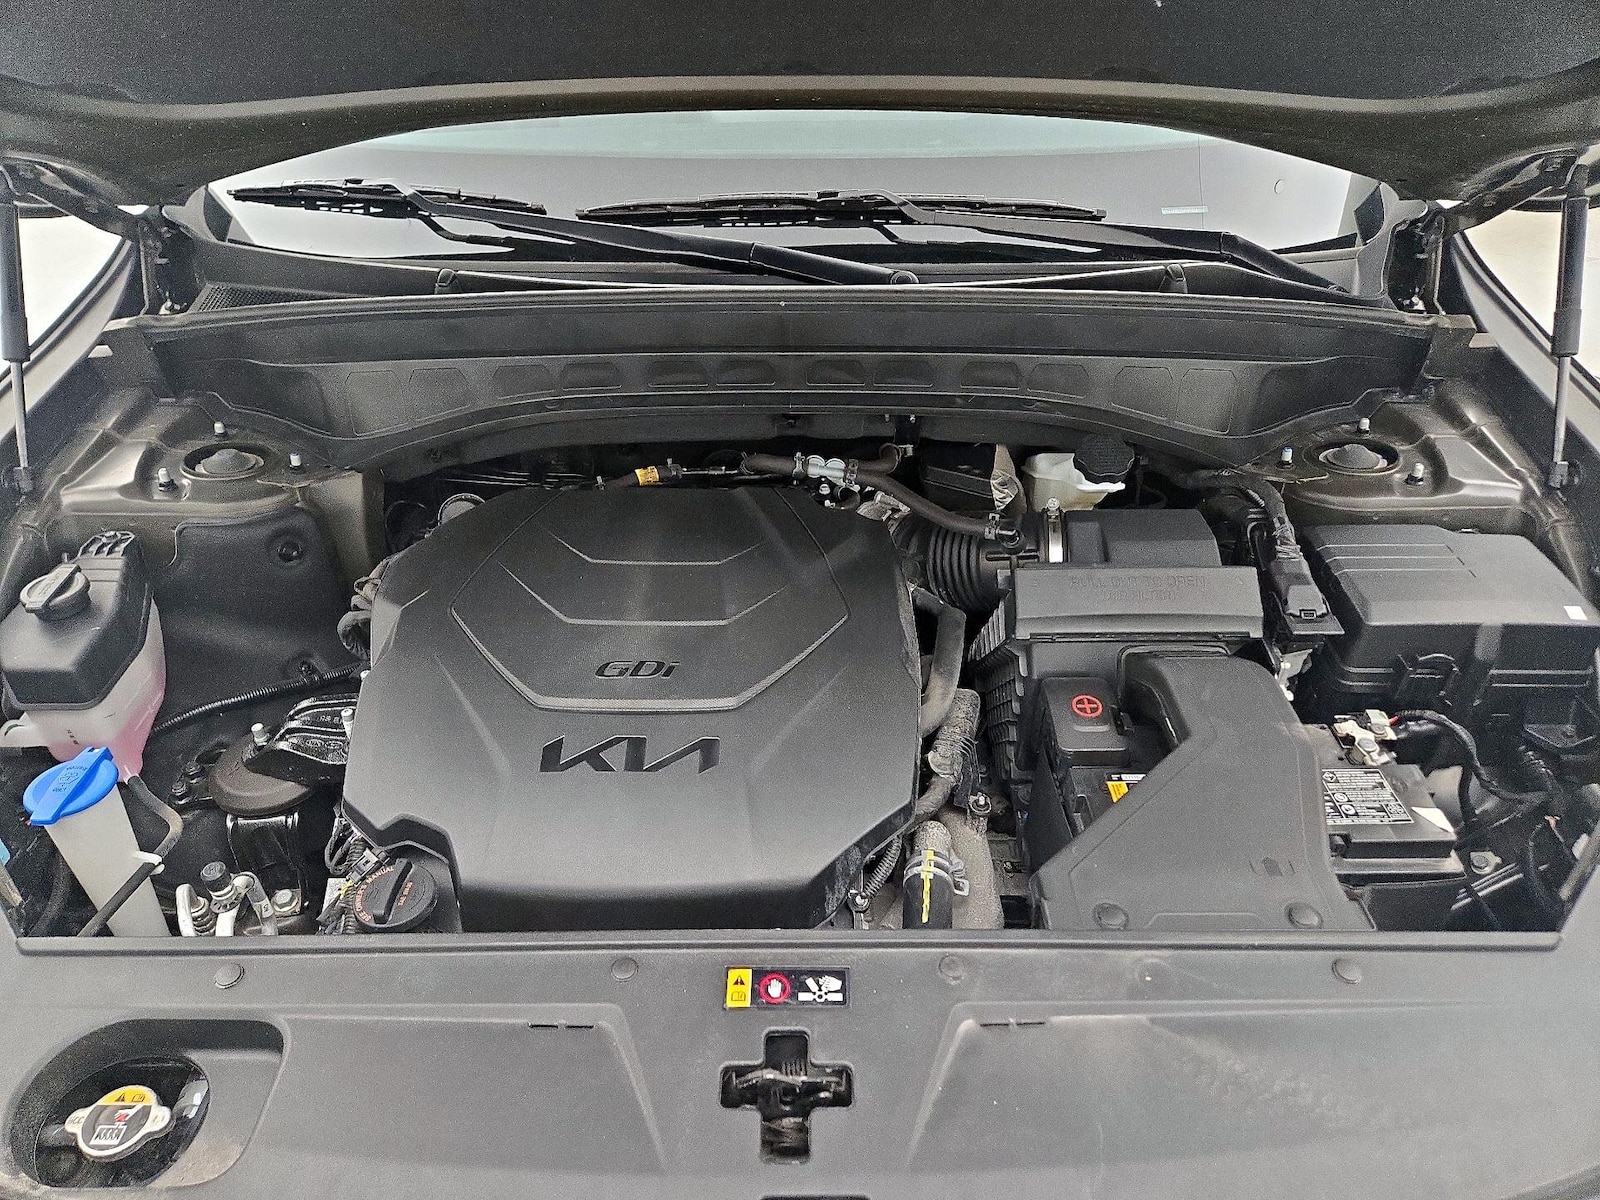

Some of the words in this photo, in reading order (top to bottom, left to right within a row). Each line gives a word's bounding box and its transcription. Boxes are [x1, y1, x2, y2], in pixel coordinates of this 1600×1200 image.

[1168, 575, 1206, 587] OPEN
[595, 660, 680, 679] GDi
[539, 734, 722, 774] KIA
[365, 865, 394, 884] MANUAL
